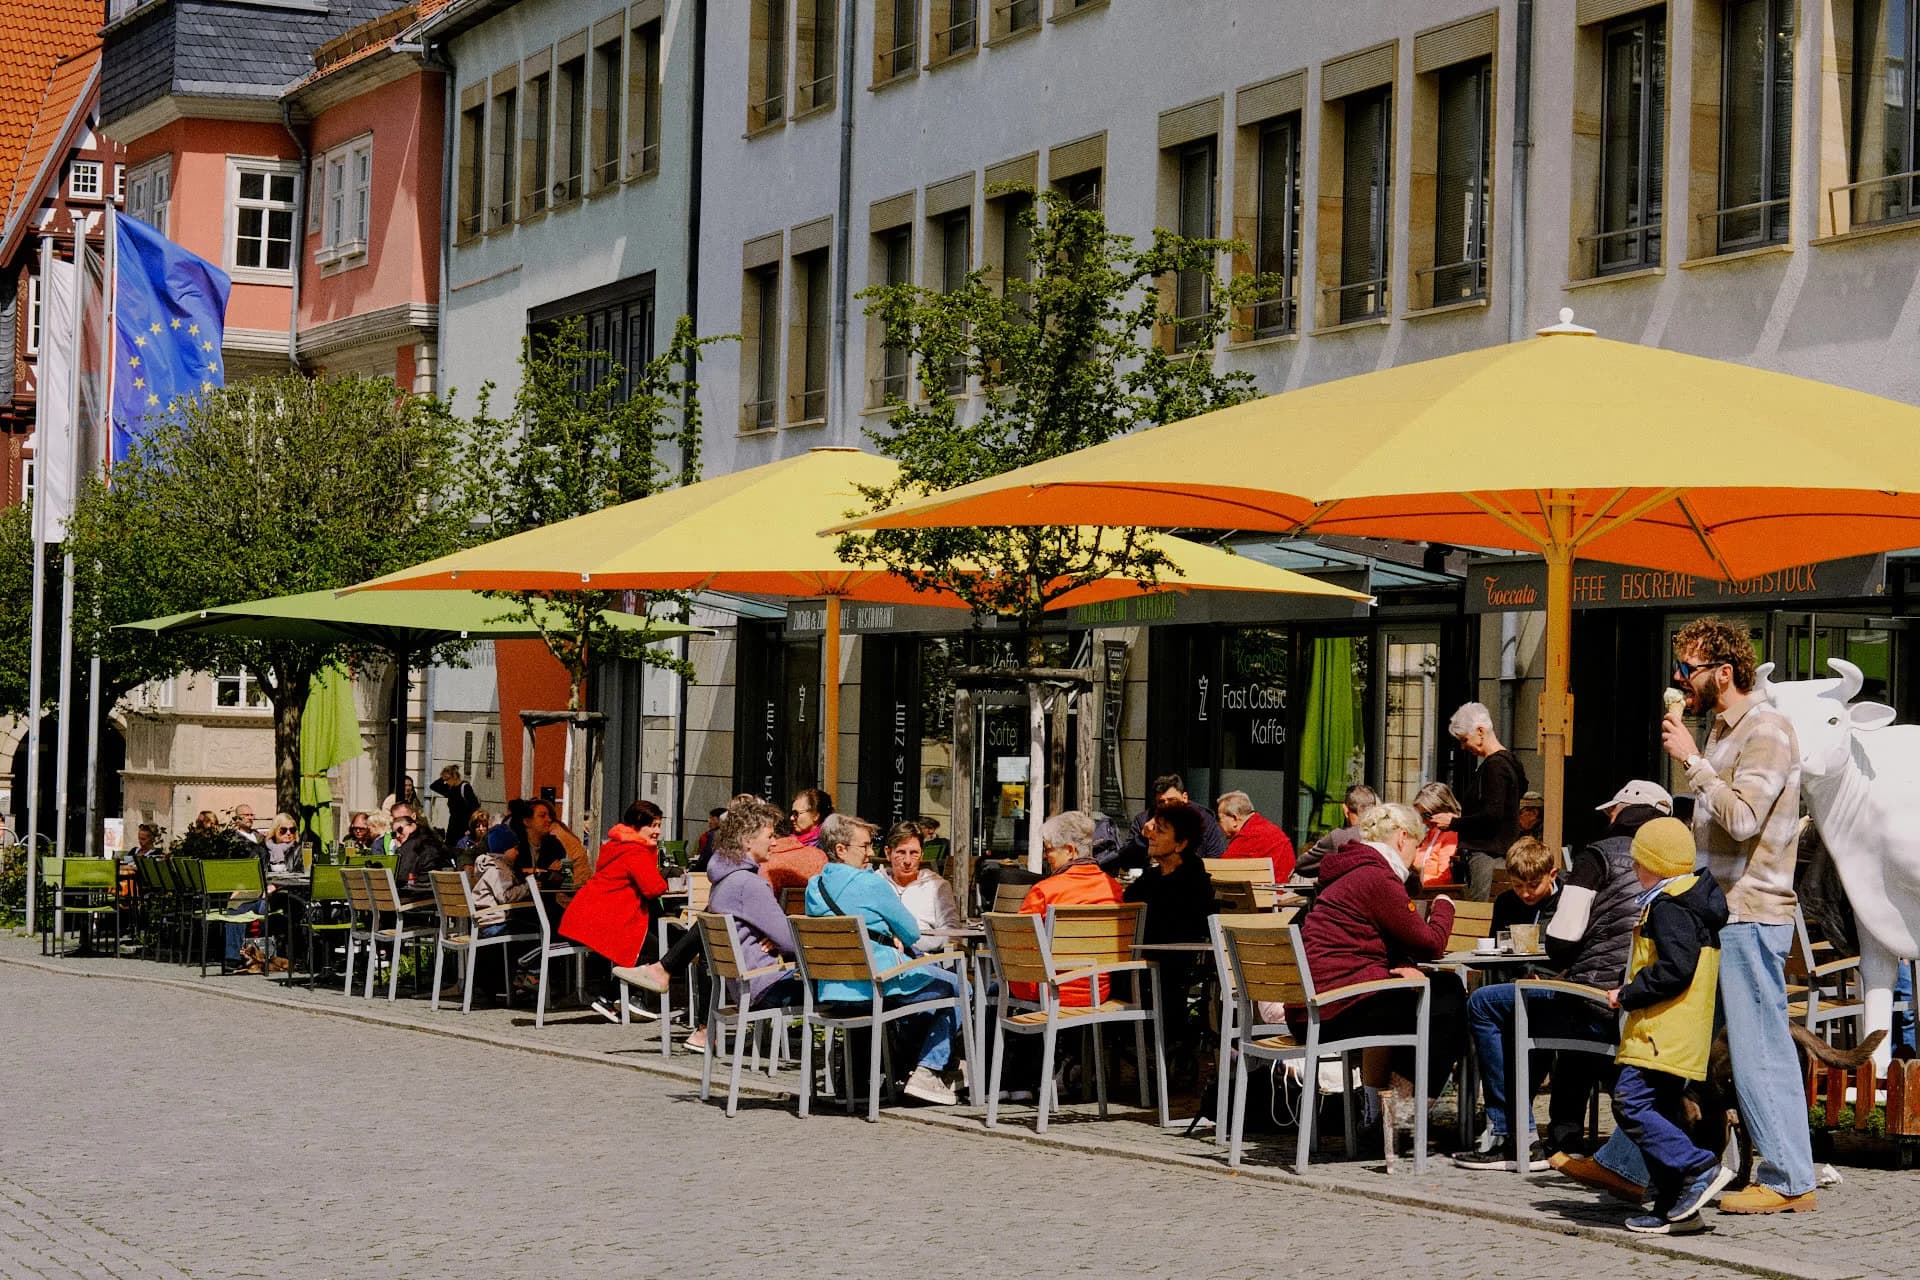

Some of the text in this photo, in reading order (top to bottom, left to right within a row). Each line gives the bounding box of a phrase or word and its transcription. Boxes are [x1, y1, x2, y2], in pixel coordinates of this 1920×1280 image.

[1484, 576, 1537, 605] Toccata
[1573, 575, 1607, 601] FFEE
[1621, 571, 1696, 600] EISCREME
[857, 607, 894, 629] RESTAURANT
[1222, 684, 1247, 709] Fast
[894, 701, 906, 746] ZIMT
[895, 754, 905, 774] &
